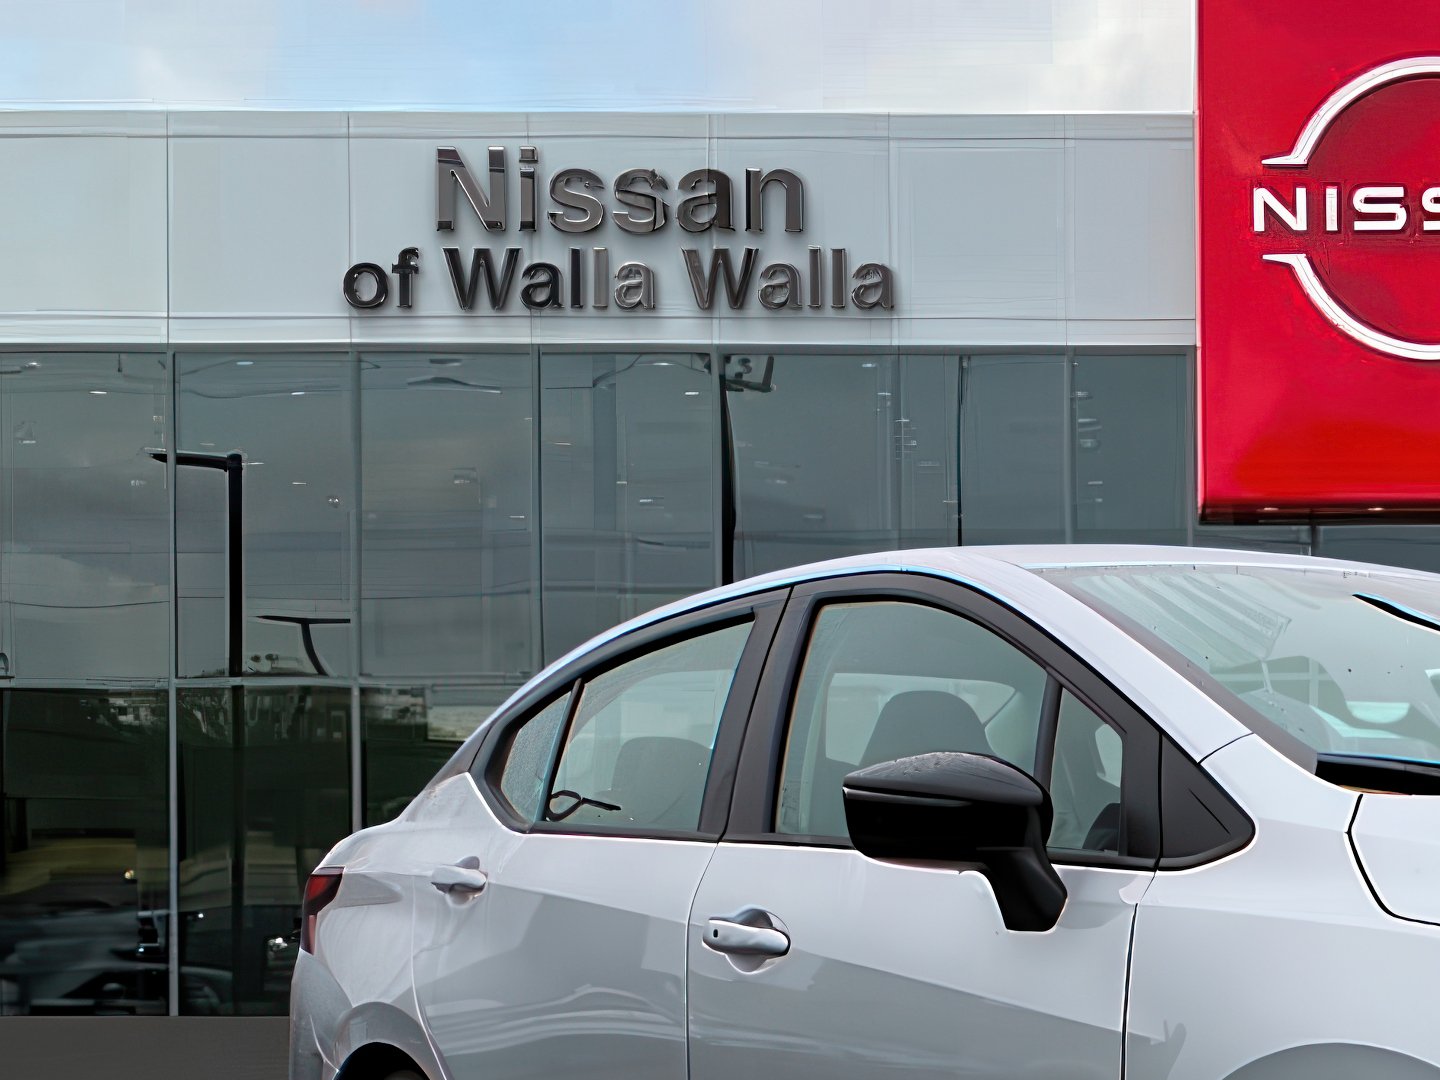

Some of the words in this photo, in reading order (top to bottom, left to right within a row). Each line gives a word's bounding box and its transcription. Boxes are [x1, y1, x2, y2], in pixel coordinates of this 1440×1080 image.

[435, 145, 806, 233] Nissan
[342, 246, 422, 309] of
[441, 245, 657, 312] Walla
[680, 244, 895, 312] Walla
